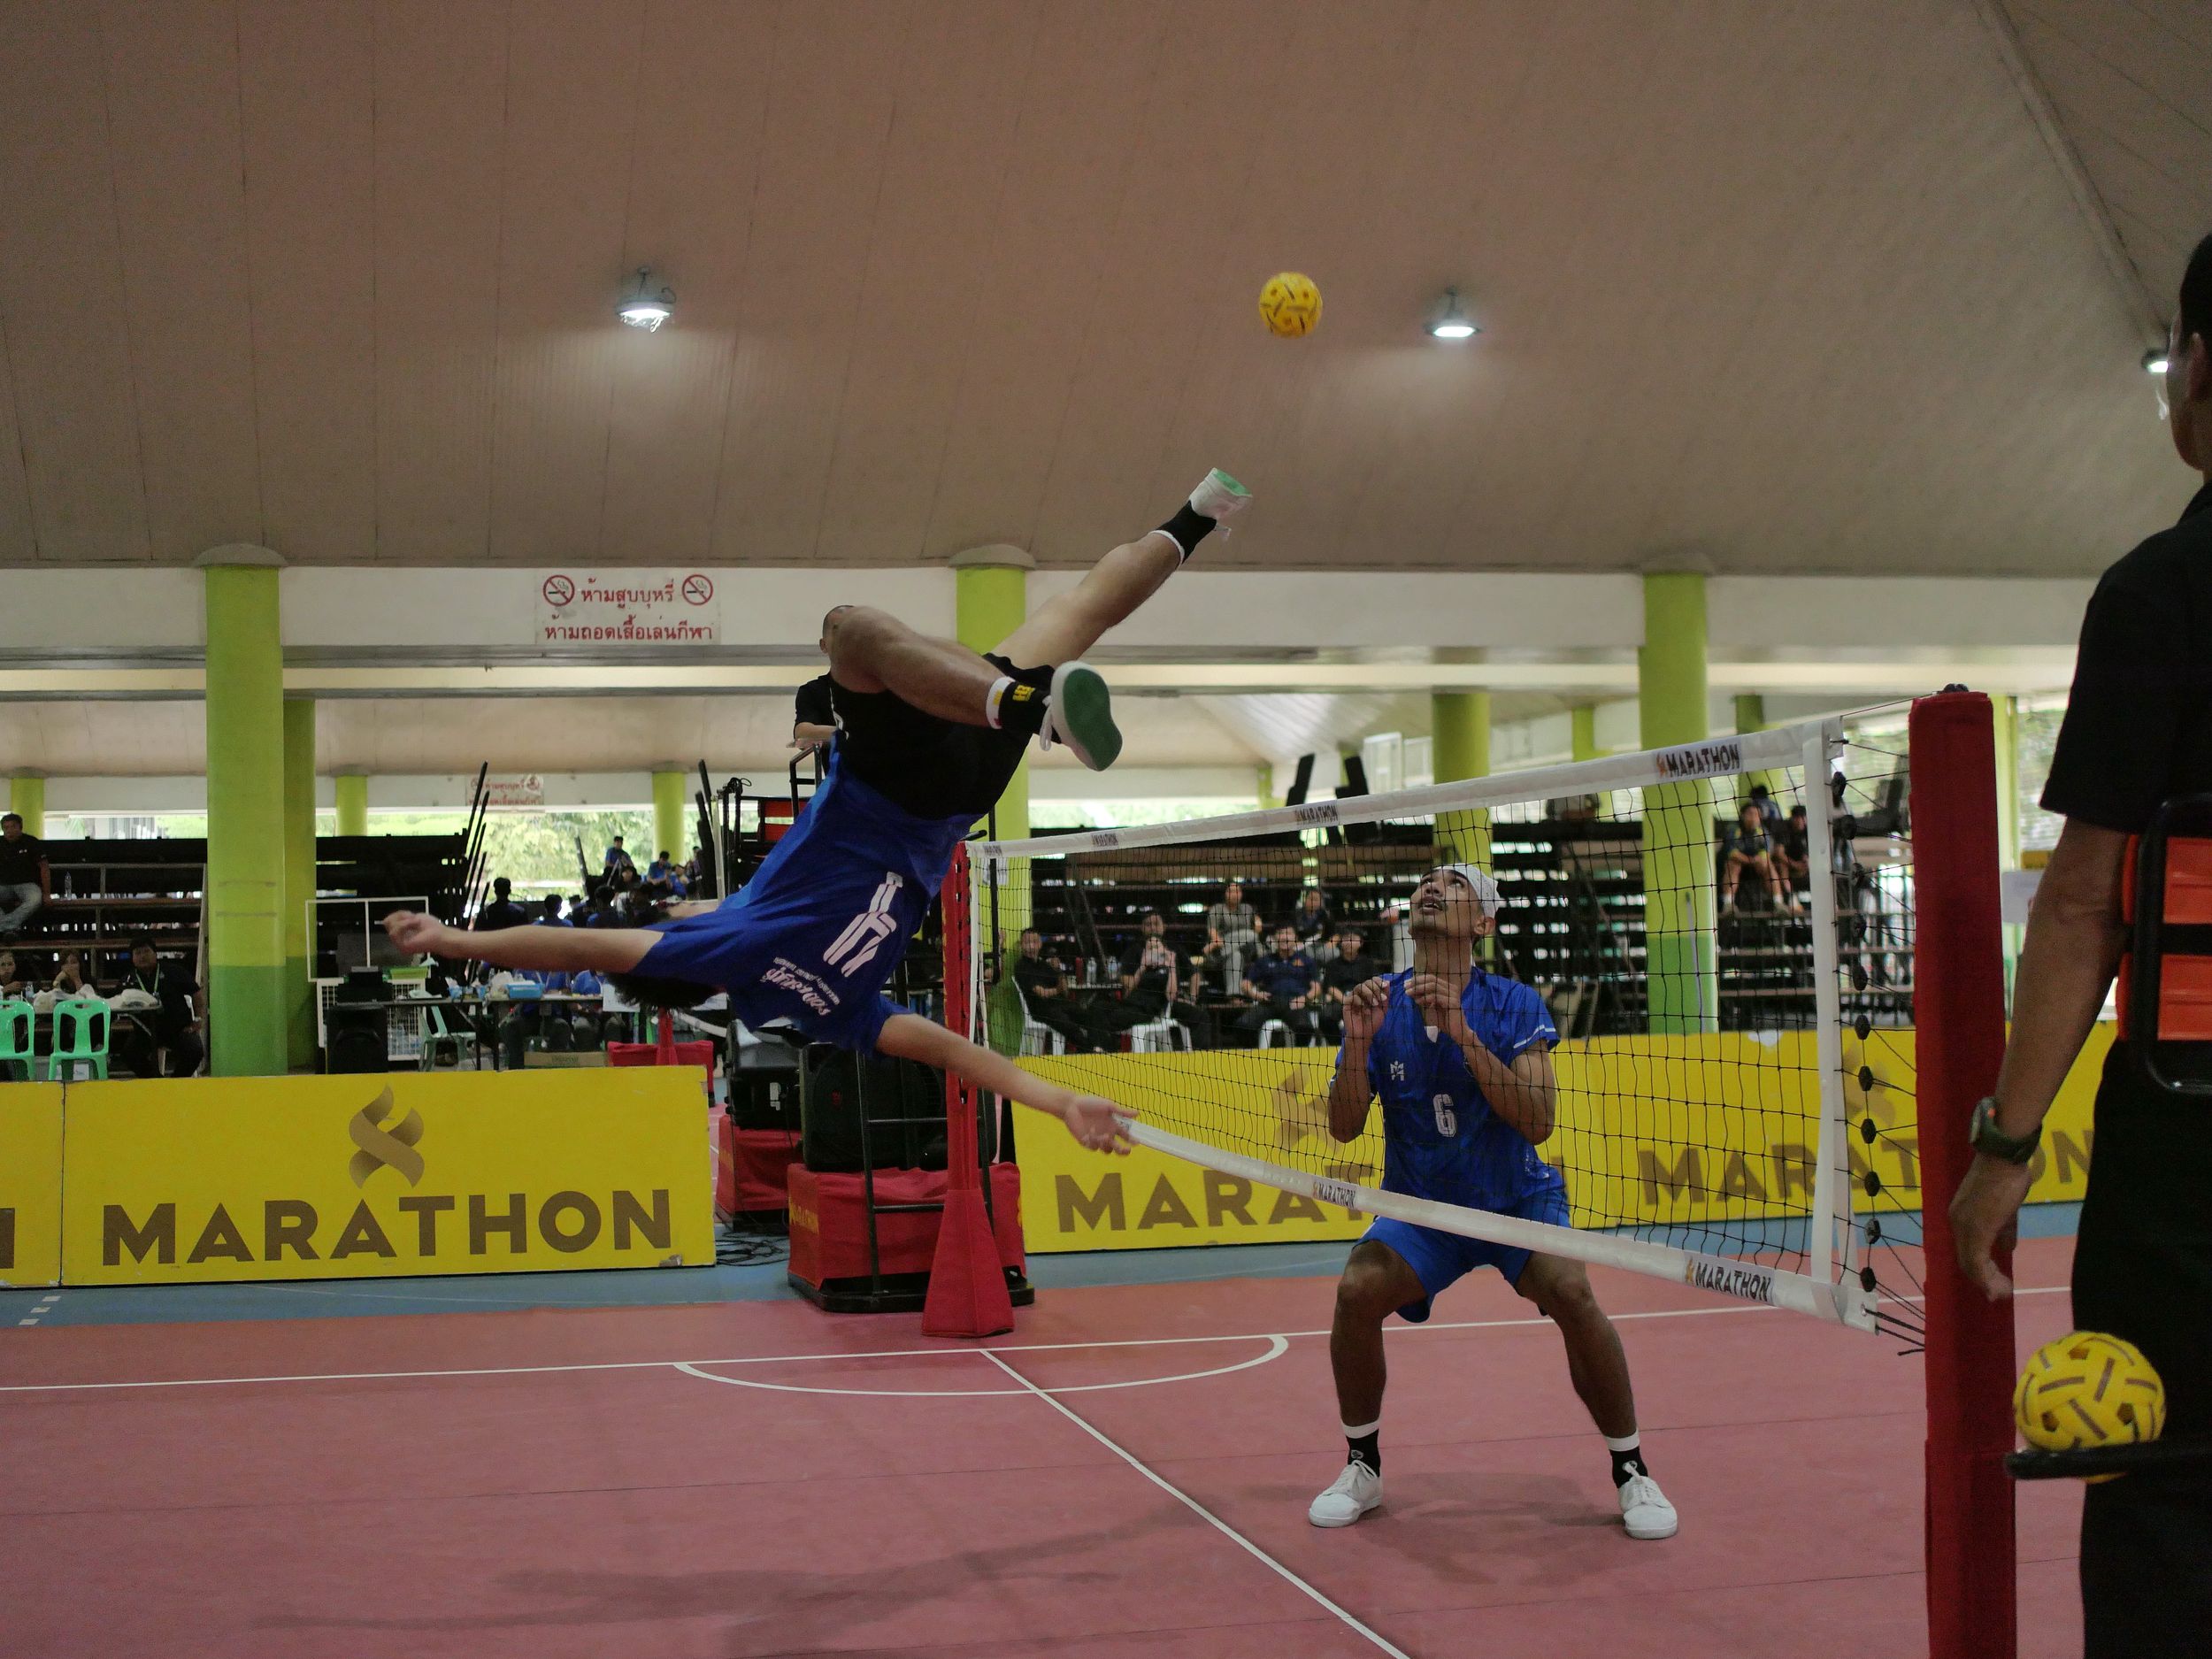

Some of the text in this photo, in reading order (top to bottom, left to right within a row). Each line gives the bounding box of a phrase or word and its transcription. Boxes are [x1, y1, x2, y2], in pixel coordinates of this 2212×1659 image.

[580, 577, 674, 608] ห้ามสูบบุหรี่
[544, 614, 712, 640] ห้ามถอดเสื้อเล่นกีฬา
[1665, 743, 1740, 777] MARATHON
[1300, 804, 1338, 824] MARATHON
[1432, 1093, 1456, 1138] 6
[1318, 1181, 1356, 1210] MARATHON
[102, 1188, 672, 1267] MARATHON
[1695, 1261, 1772, 1302] MARATHON
